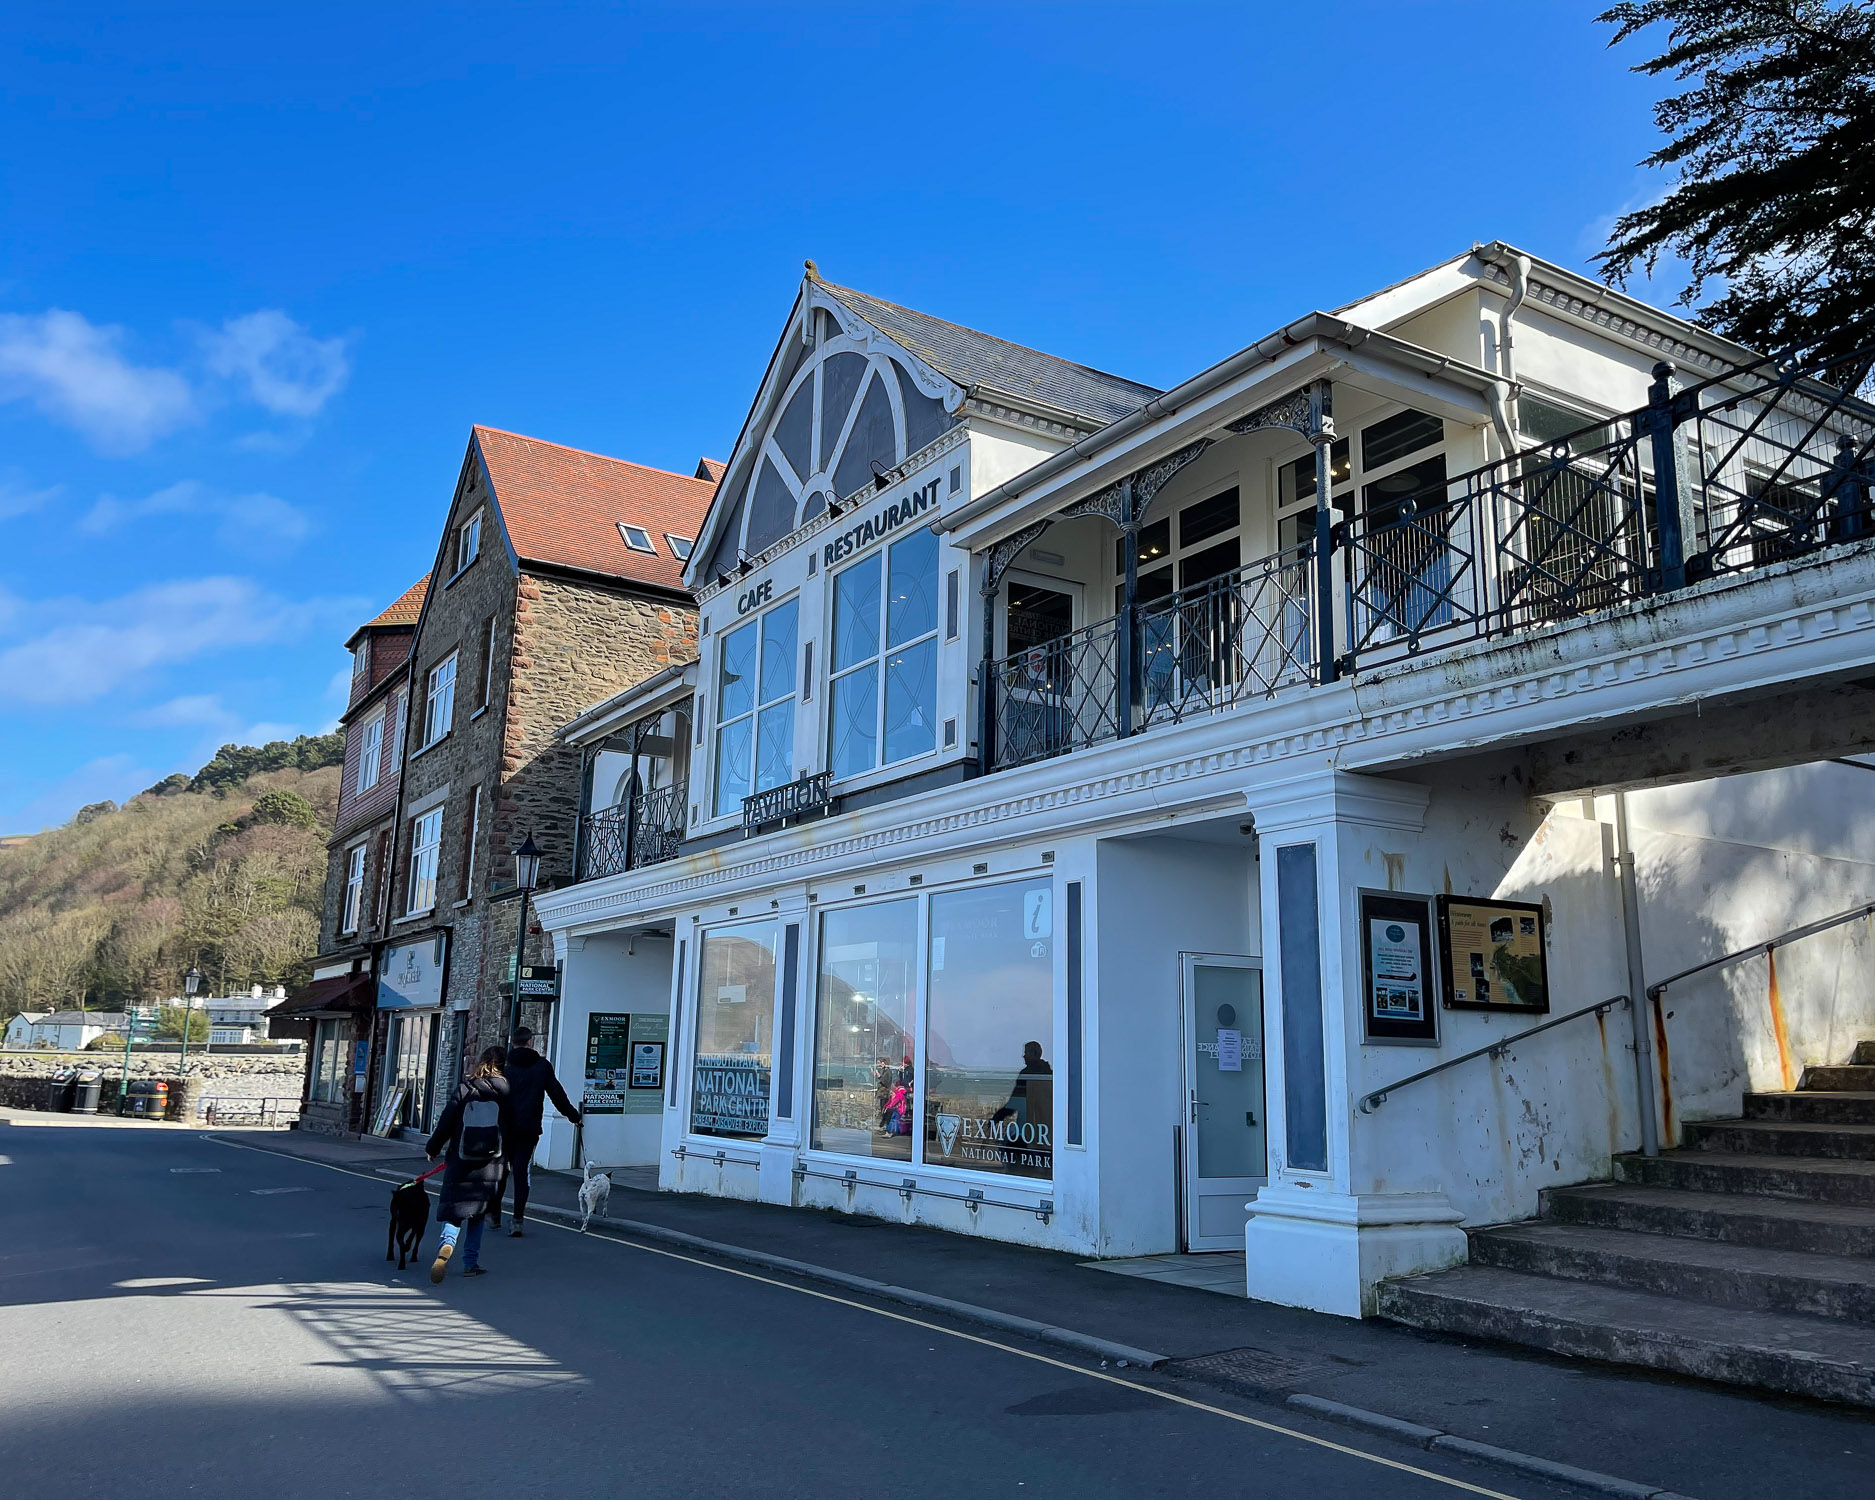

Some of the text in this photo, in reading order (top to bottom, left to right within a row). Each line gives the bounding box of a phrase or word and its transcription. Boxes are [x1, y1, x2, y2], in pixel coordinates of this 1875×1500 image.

[824, 477, 941, 567] RESTAURANT
[737, 578, 773, 615] CAFE
[743, 773, 829, 828] PAVILION
[696, 1070, 764, 1096] NATIONAL
[701, 1095, 726, 1114] PARK
[962, 1117, 1051, 1146] EXMOOR
[961, 1147, 1051, 1168] NATIONAL PARK
